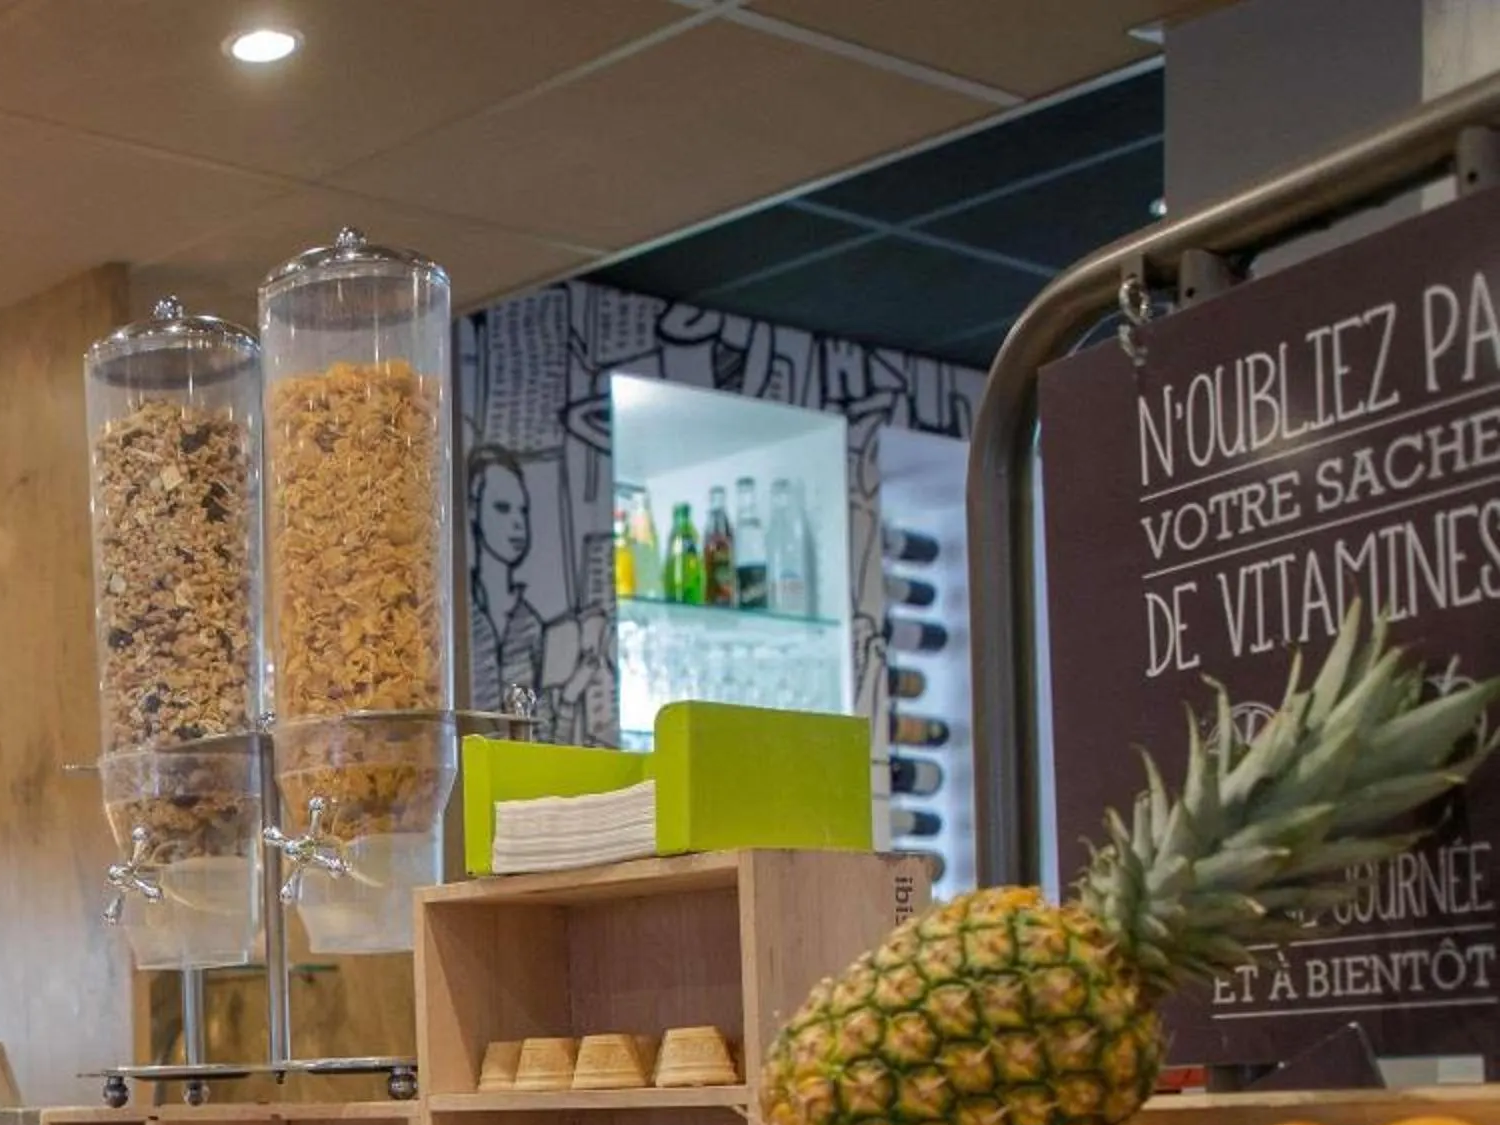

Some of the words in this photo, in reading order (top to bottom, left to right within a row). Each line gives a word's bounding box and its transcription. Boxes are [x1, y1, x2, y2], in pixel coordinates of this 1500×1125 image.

[1139, 302, 1400, 487] N'OUBLIEZ
[1141, 470, 1301, 560] VOTRE
[1145, 582, 1201, 678] DE
[1212, 964, 1258, 1005] ET
[1268, 951, 1298, 1001] À
[1306, 936, 1496, 999] BIENTÔT
